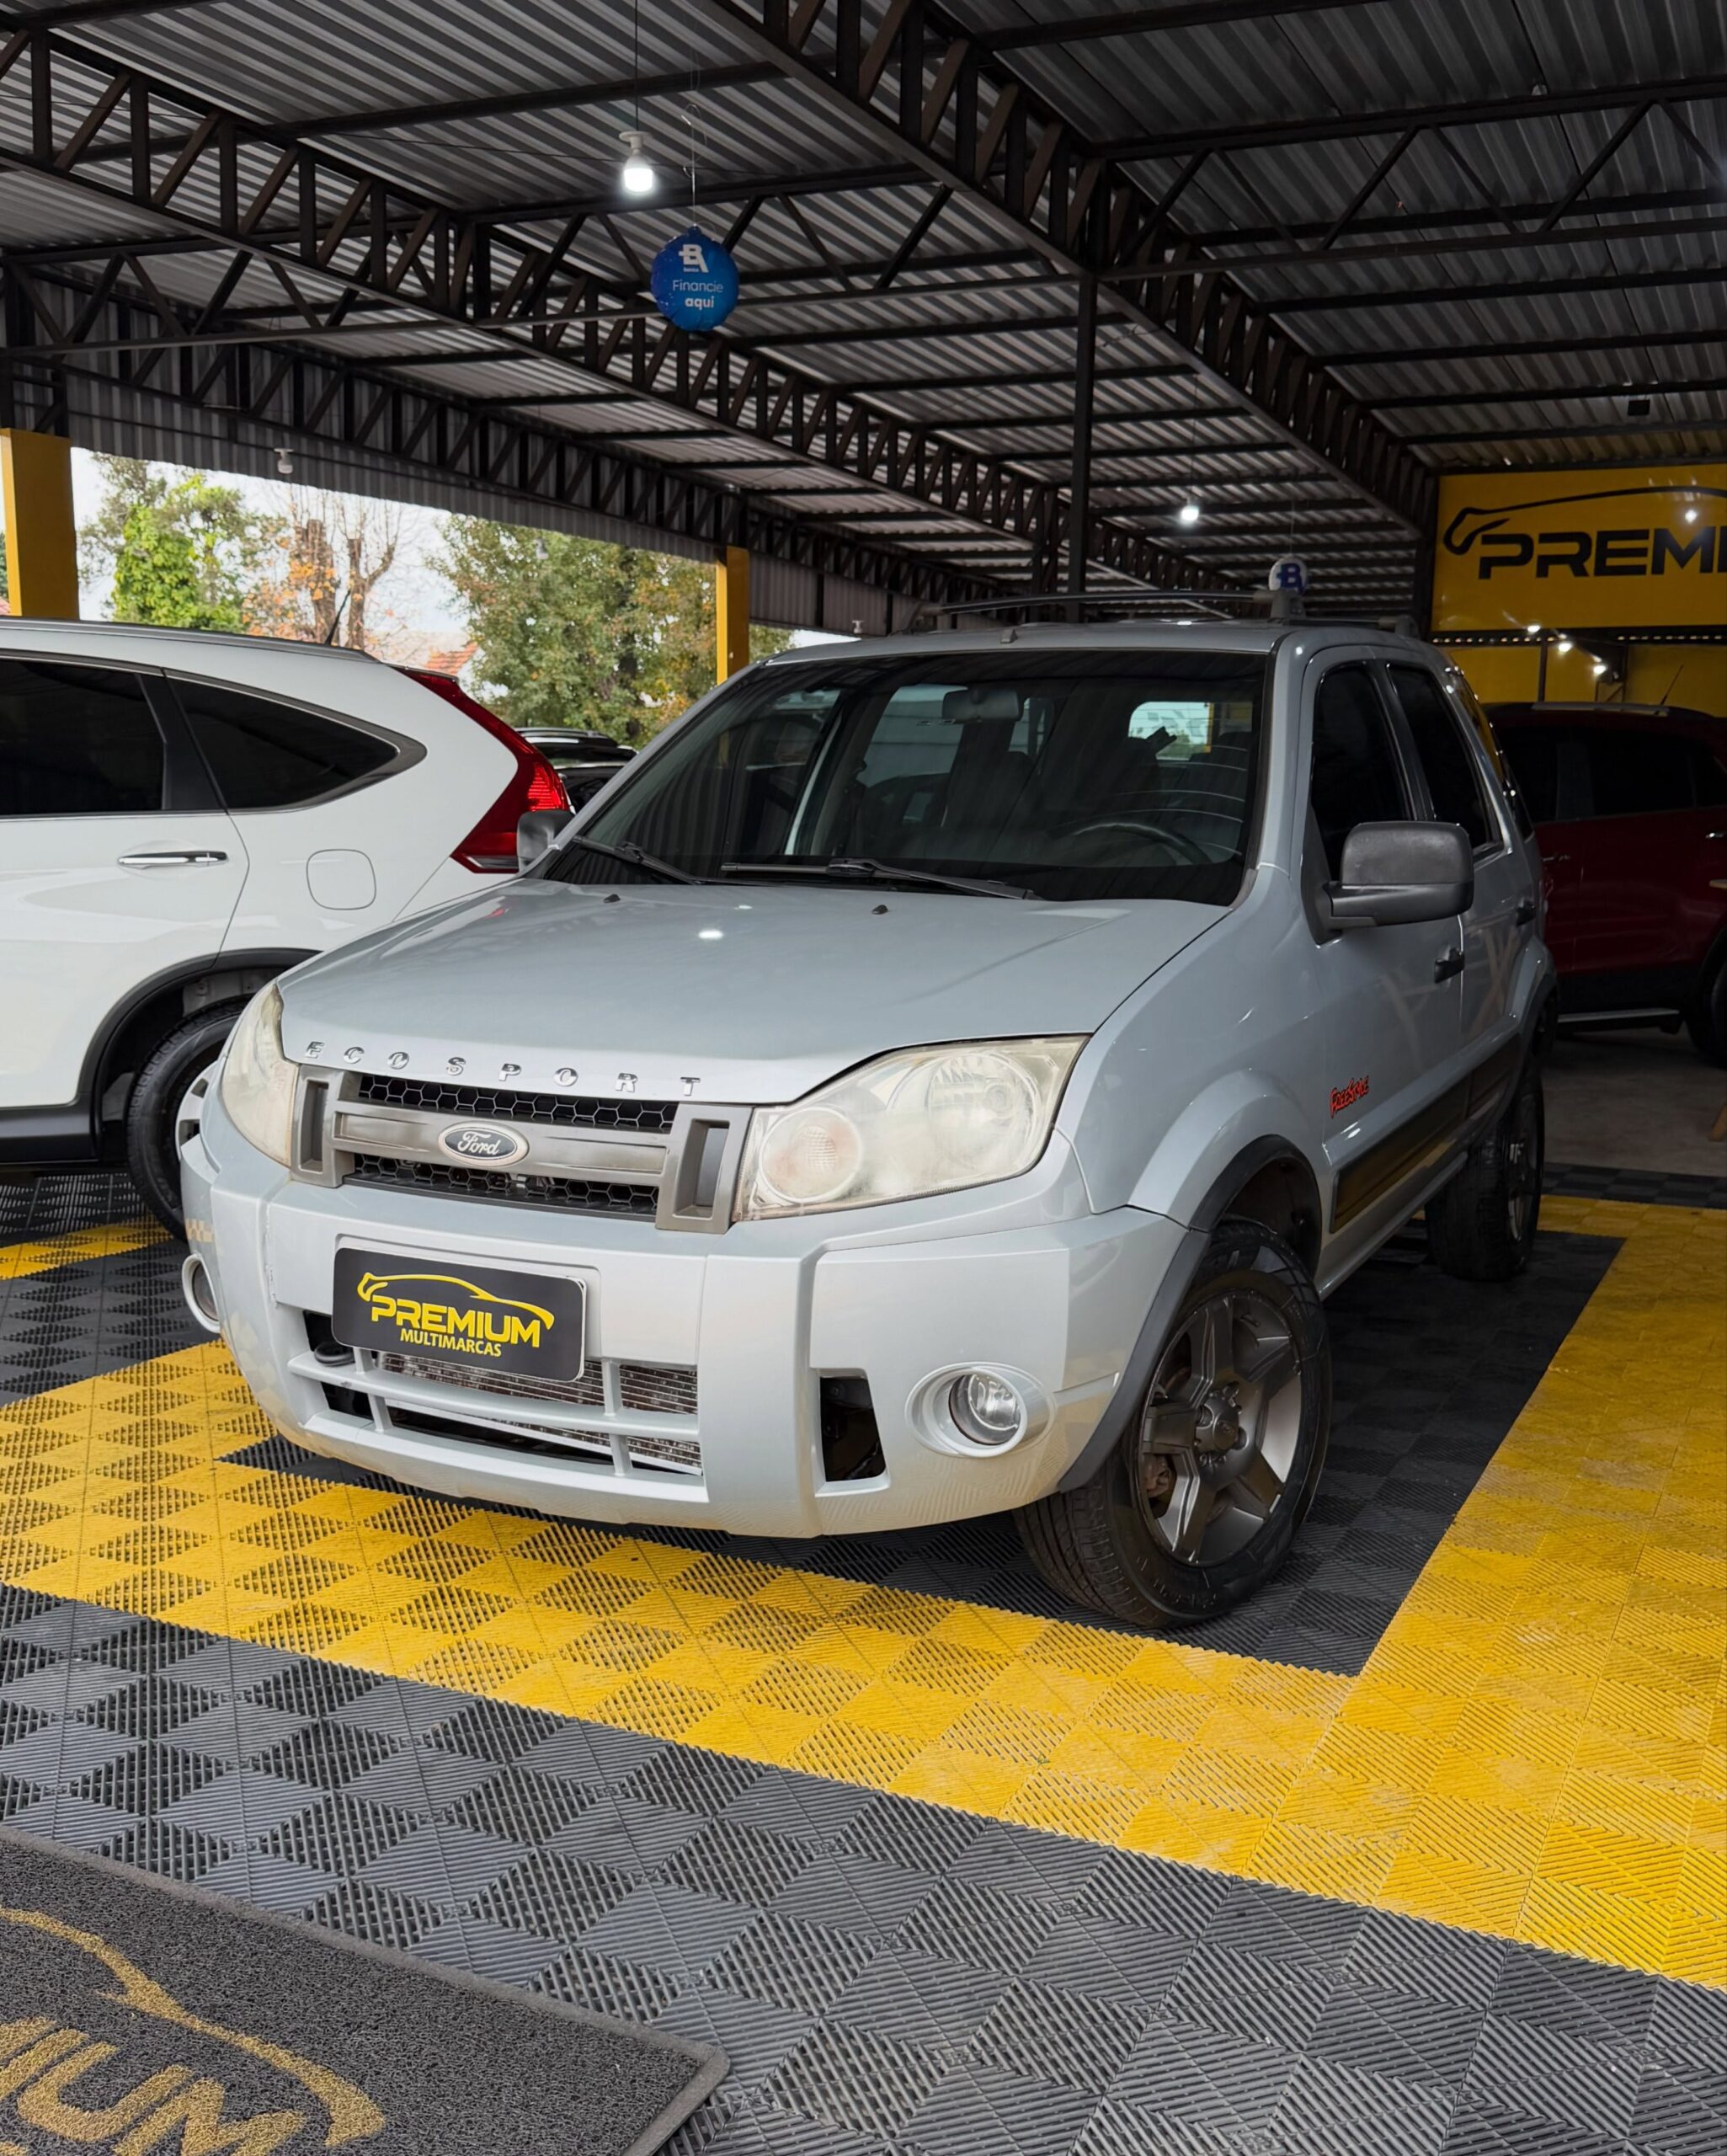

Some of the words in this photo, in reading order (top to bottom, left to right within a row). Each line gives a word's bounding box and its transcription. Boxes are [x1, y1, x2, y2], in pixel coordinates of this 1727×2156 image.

[673, 280, 724, 293] Financie
[685, 296, 714, 310] aqui
[305, 1041, 701, 1097] ECOSPORT
[456, 1131, 500, 1156] Ford
[370, 1295, 541, 1348] PREMIUM
[399, 1328, 503, 1358] MULTIMARCAS
